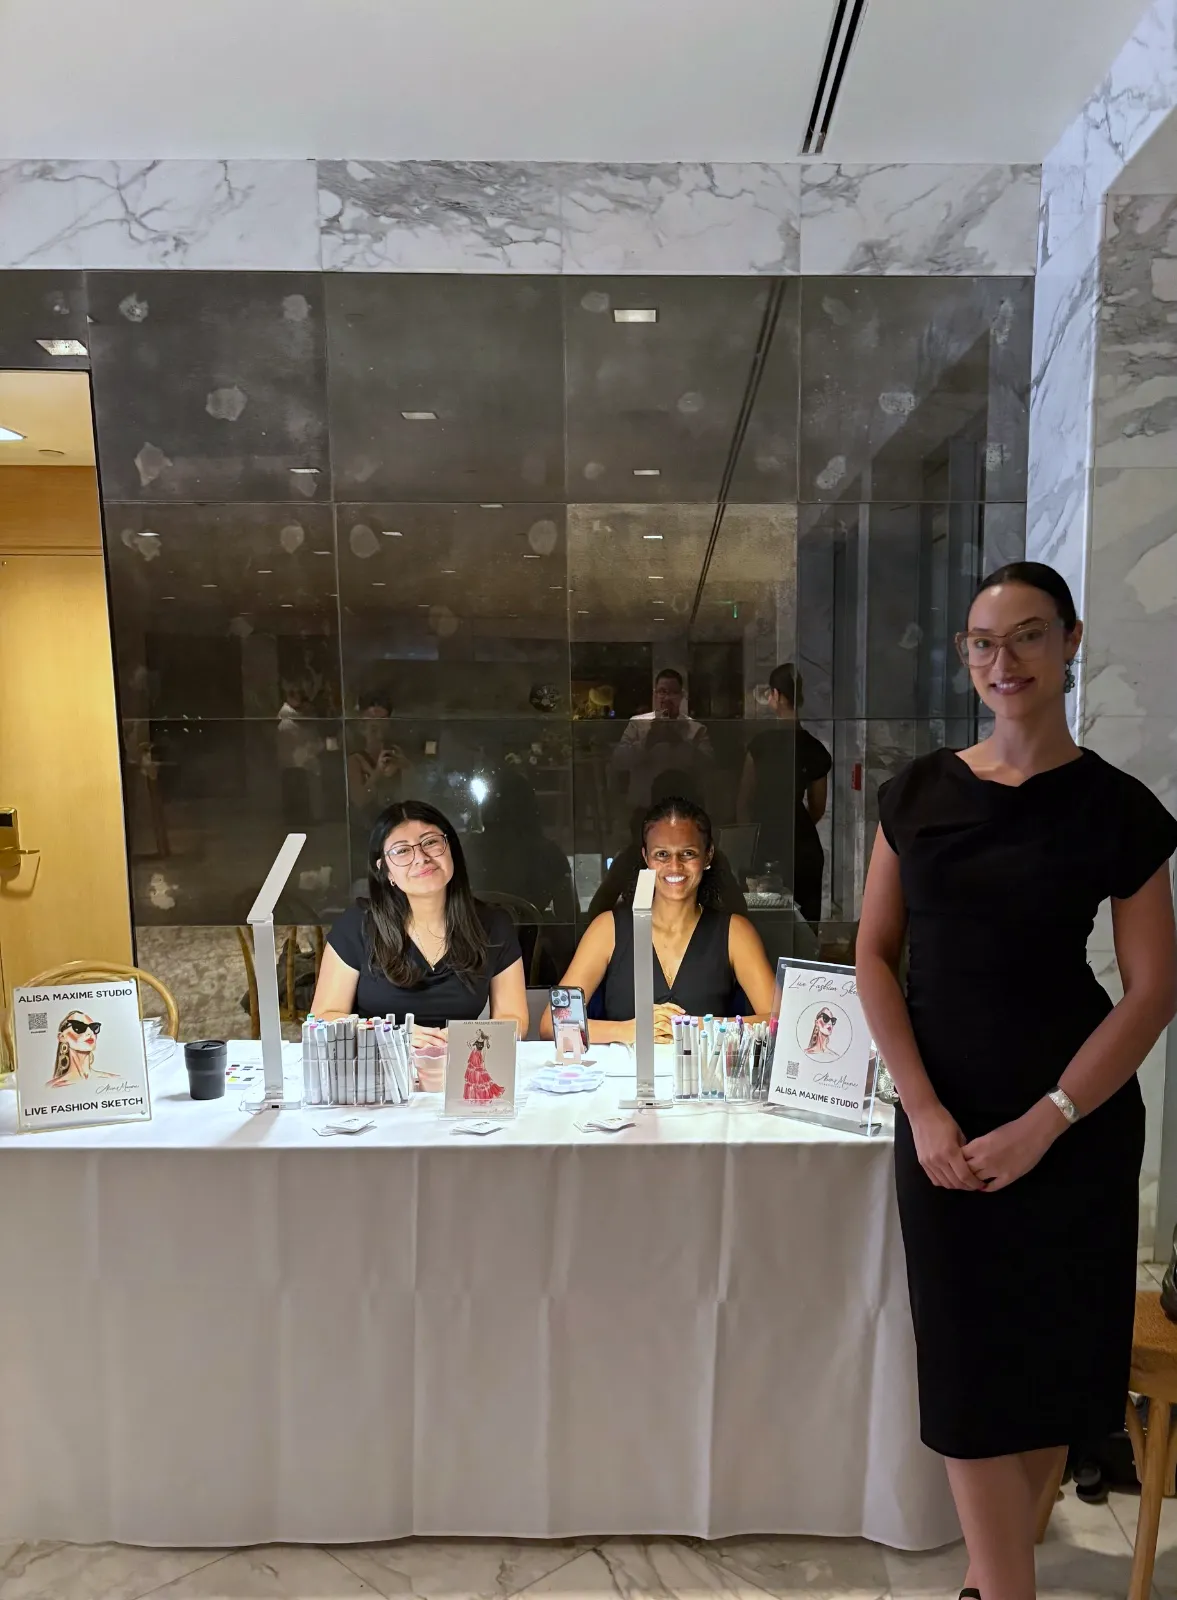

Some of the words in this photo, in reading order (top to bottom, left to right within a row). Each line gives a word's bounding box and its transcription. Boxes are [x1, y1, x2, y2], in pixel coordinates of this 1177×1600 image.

[18, 994, 50, 1003] ALISA
[52, 991, 94, 1001] MAXIME
[96, 988, 133, 998] STUDIO
[25, 1107, 47, 1116] LIVE
[51, 1102, 98, 1113] FASHION
[101, 1097, 143, 1108] SKETCH
[775, 1085, 797, 1096] ALISA
[799, 1090, 828, 1103] MAXIME
[830, 1097, 859, 1109] STUDIO
